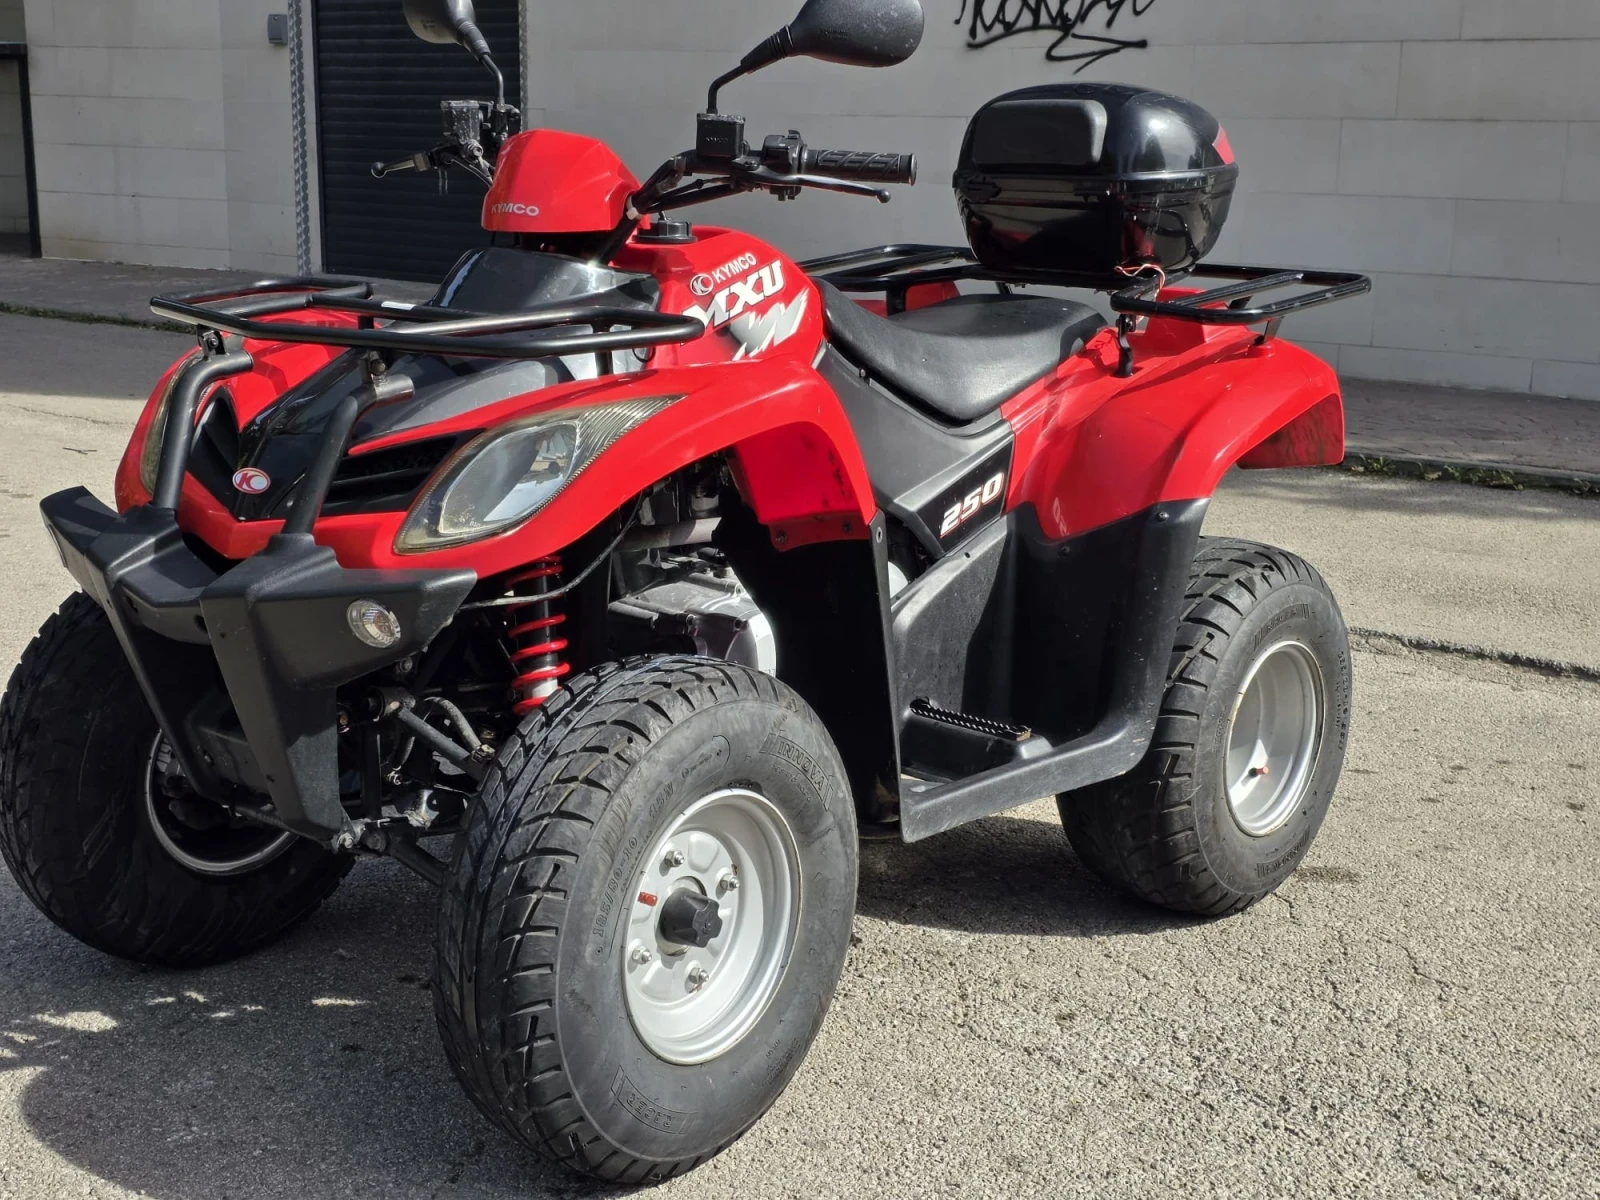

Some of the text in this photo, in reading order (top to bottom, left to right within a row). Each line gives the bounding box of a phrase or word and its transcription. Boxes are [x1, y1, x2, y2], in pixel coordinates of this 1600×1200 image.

[491, 202, 540, 217] KYMCO
[712, 252, 757, 283] KYMCO
[682, 259, 785, 329] MXU
[941, 472, 1005, 539] 250
[778, 740, 825, 792] INNOVA
